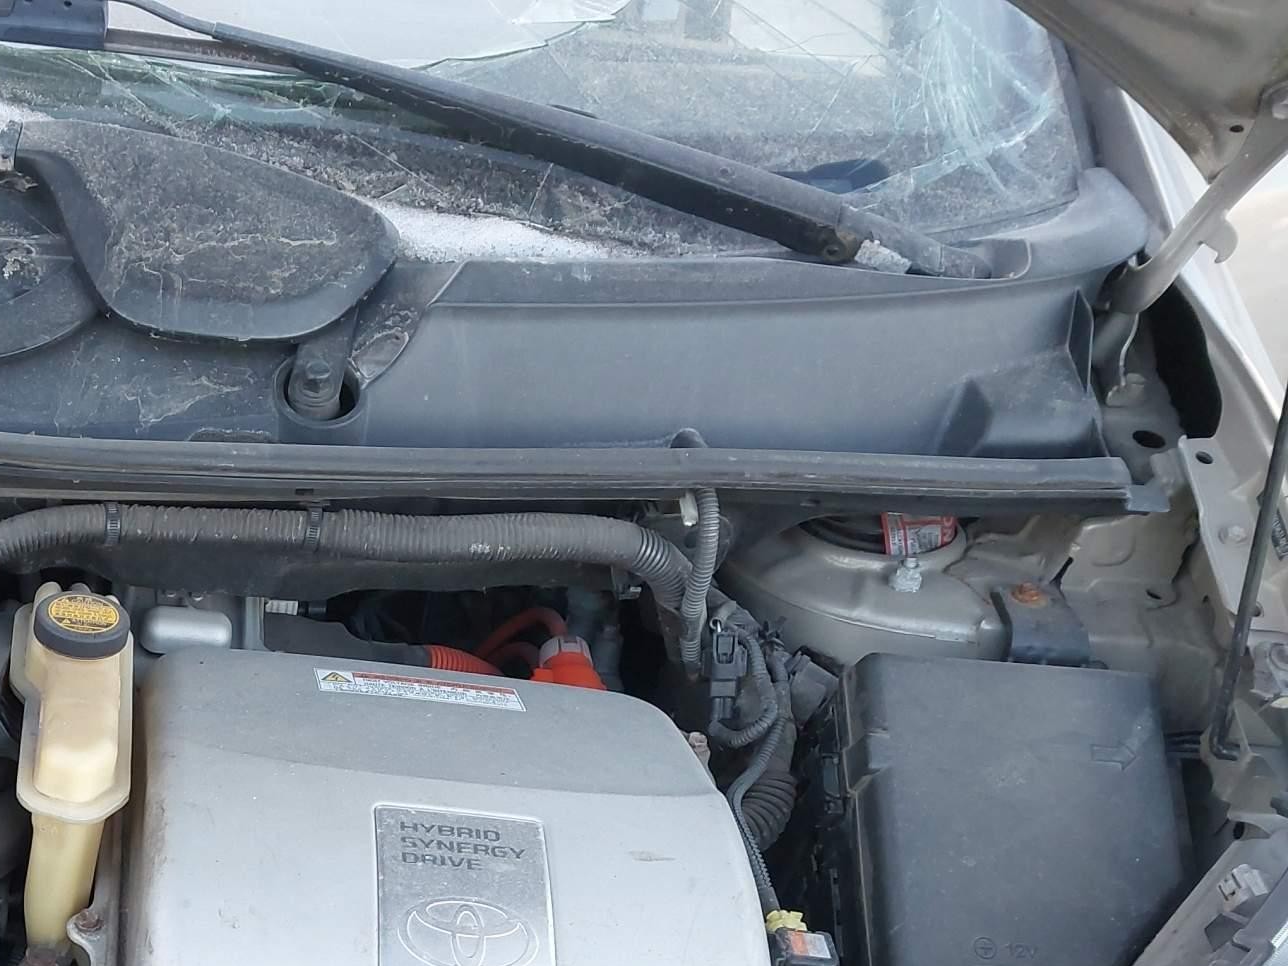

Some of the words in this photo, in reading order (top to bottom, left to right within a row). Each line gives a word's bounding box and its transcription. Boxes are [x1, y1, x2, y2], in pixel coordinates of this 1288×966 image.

[399, 820, 501, 842] HYBRID
[401, 835, 526, 860] SYNERGY
[401, 851, 483, 871] DRIVE
[1005, 943, 1039, 960] 12V
